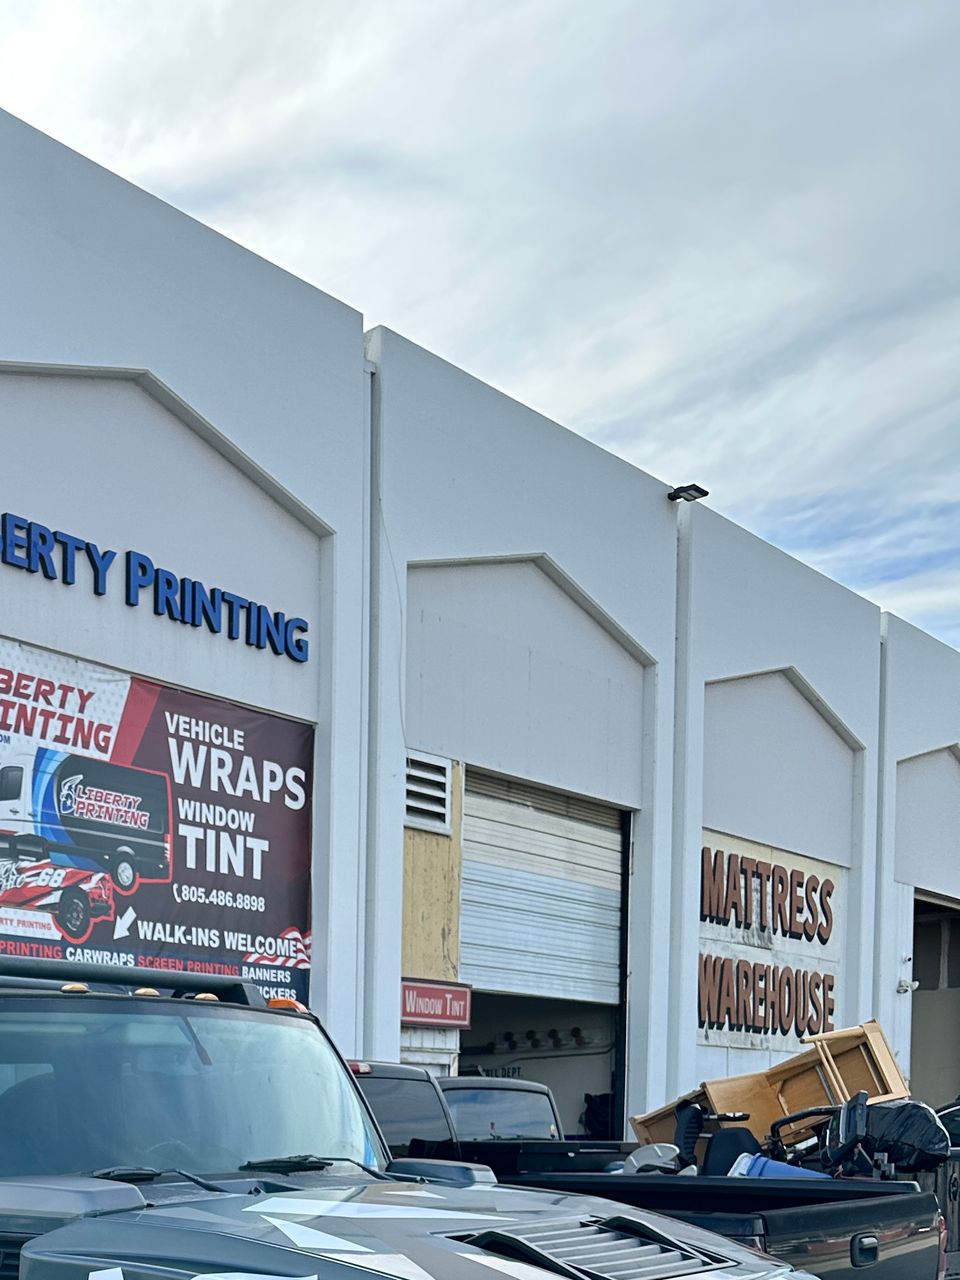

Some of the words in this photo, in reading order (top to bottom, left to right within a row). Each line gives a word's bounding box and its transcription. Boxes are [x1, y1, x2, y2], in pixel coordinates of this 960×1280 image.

[125, 551, 308, 663] PRINTING
[165, 711, 244, 751] VEHICLE
[168, 737, 305, 810] WRAPS
[74, 801, 150, 830] PRINTING
[76, 785, 141, 810] LIBERTY
[178, 798, 255, 832] WINDOW
[178, 823, 269, 880] TINT
[36, 868, 66, 888] 68
[700, 847, 834, 945] MATTRESS
[181, 885, 265, 912] 805.486.8898
[137, 919, 220, 948] WALK-INS
[224, 931, 298, 958] WELCOME
[66, 947, 135, 967] CARWRAPS
[137, 955, 184, 972] SCREEN
[187, 960, 240, 977] PRINTING
[242, 965, 291, 983] BANNERS
[698, 953, 834, 1038] WAREHOUSE
